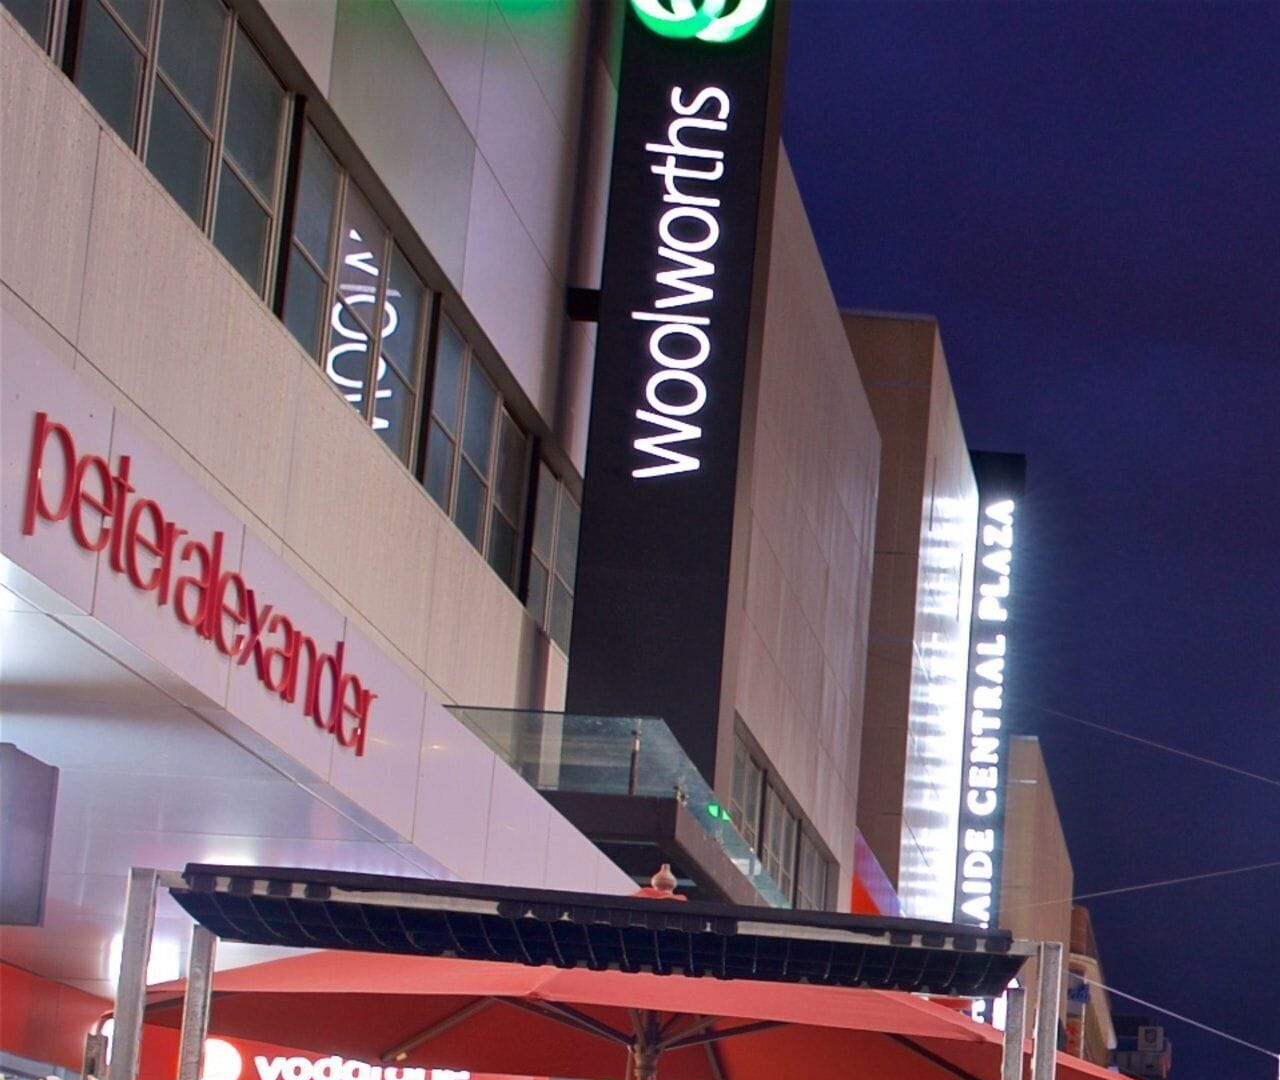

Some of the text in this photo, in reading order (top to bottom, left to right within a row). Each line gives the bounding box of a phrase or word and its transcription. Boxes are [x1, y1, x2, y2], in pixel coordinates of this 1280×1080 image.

[631, 85, 731, 481] Woolworths
[960, 499, 1015, 929] AIDE CENTRAL PLAZA
